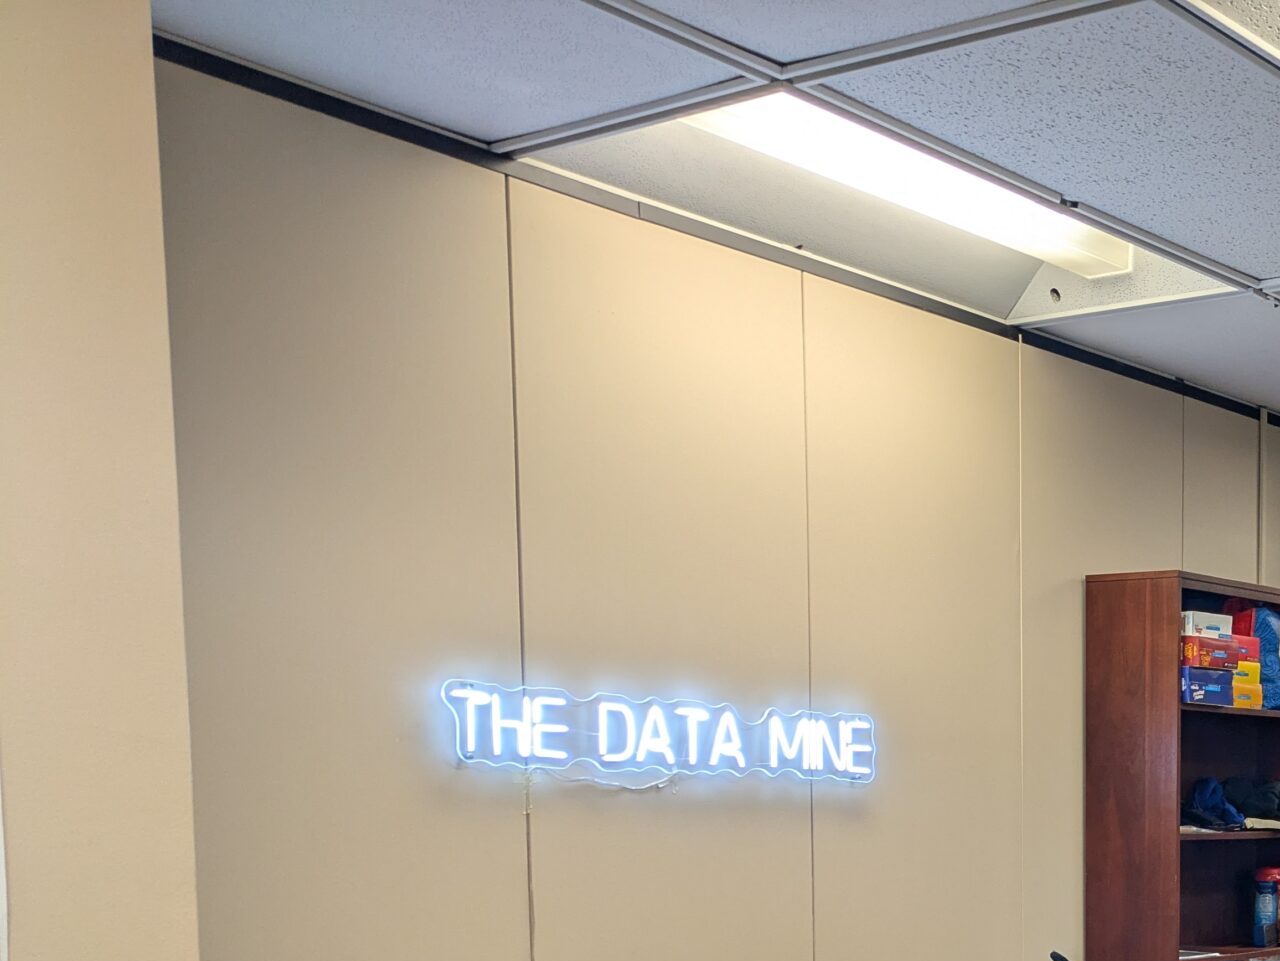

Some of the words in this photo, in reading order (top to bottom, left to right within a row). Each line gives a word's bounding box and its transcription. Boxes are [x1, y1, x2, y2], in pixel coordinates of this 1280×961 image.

[449, 688, 569, 759] THE
[598, 700, 746, 768] DATA
[769, 714, 872, 775] MINE
